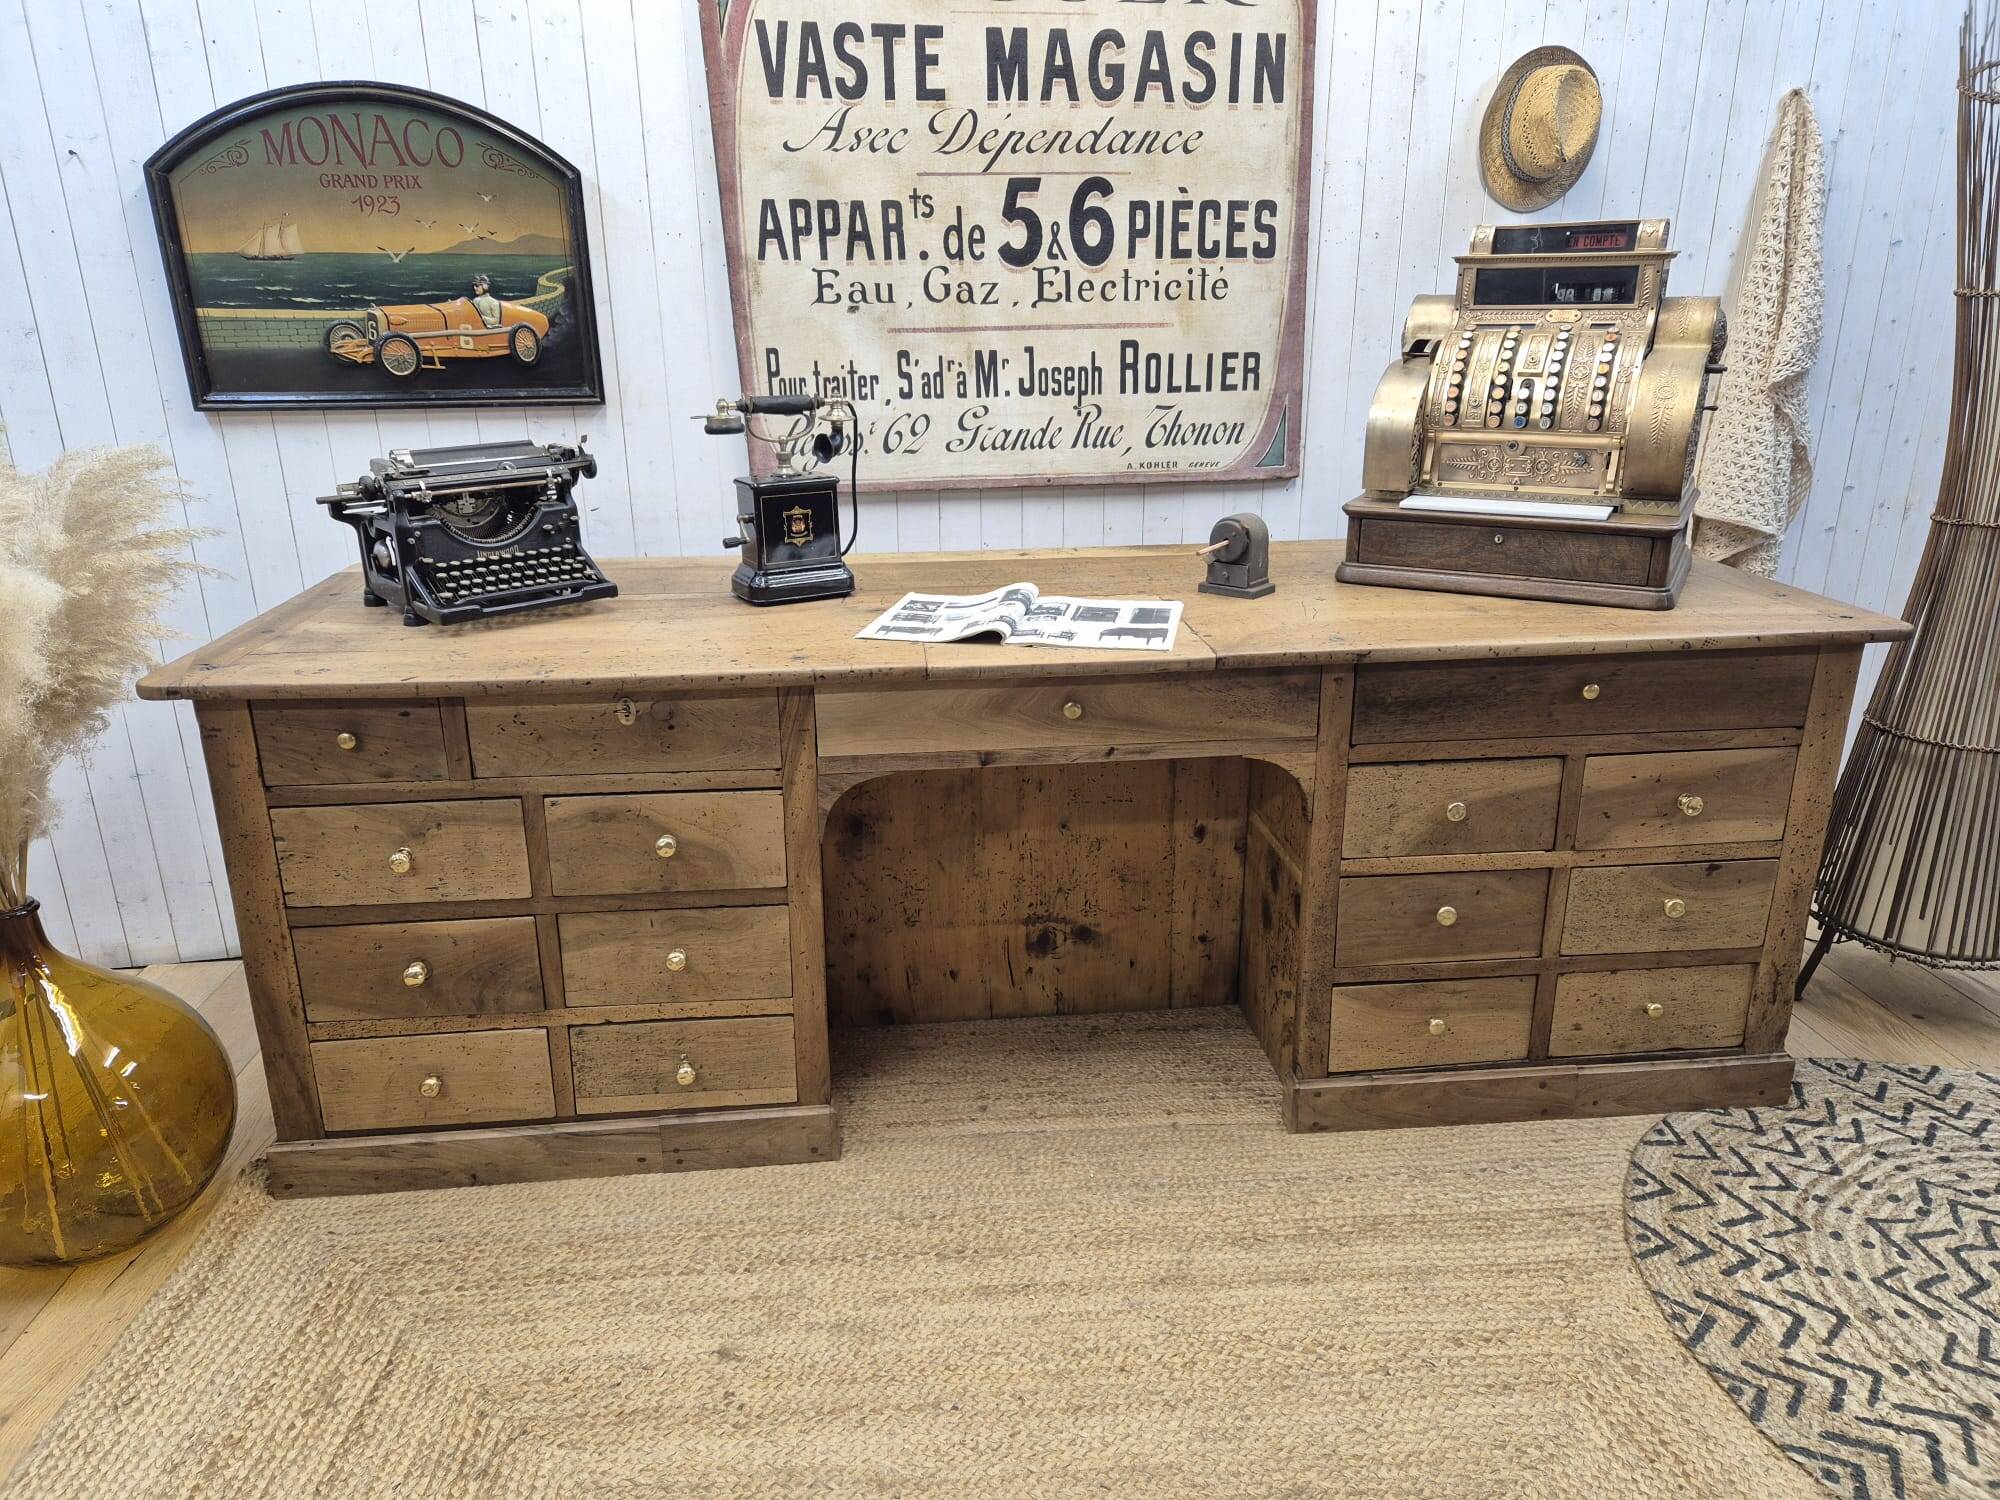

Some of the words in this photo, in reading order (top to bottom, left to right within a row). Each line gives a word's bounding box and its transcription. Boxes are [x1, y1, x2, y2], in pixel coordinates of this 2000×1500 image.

[755, 19, 947, 102] VASTE
[985, 27, 1287, 104] MAGASIN
[259, 113, 464, 170] MONACO
[928, 108, 1204, 173] Dépendance
[319, 173, 378, 189] GRAND
[384, 175, 422, 189] PRIX
[352, 195, 400, 216] 1923
[943, 206, 985, 261] de
[1128, 187, 1278, 259] PIÈCES
[369, 321, 378, 340] 6
[766, 347, 806, 396] Pour
[1018, 346, 1103, 416] Joseph
[1120, 339, 1261, 394] ROLLIER
[883, 412, 931, 454] 62
[945, 404, 1063, 452] Grande
[1144, 404, 1246, 448] Thonon
